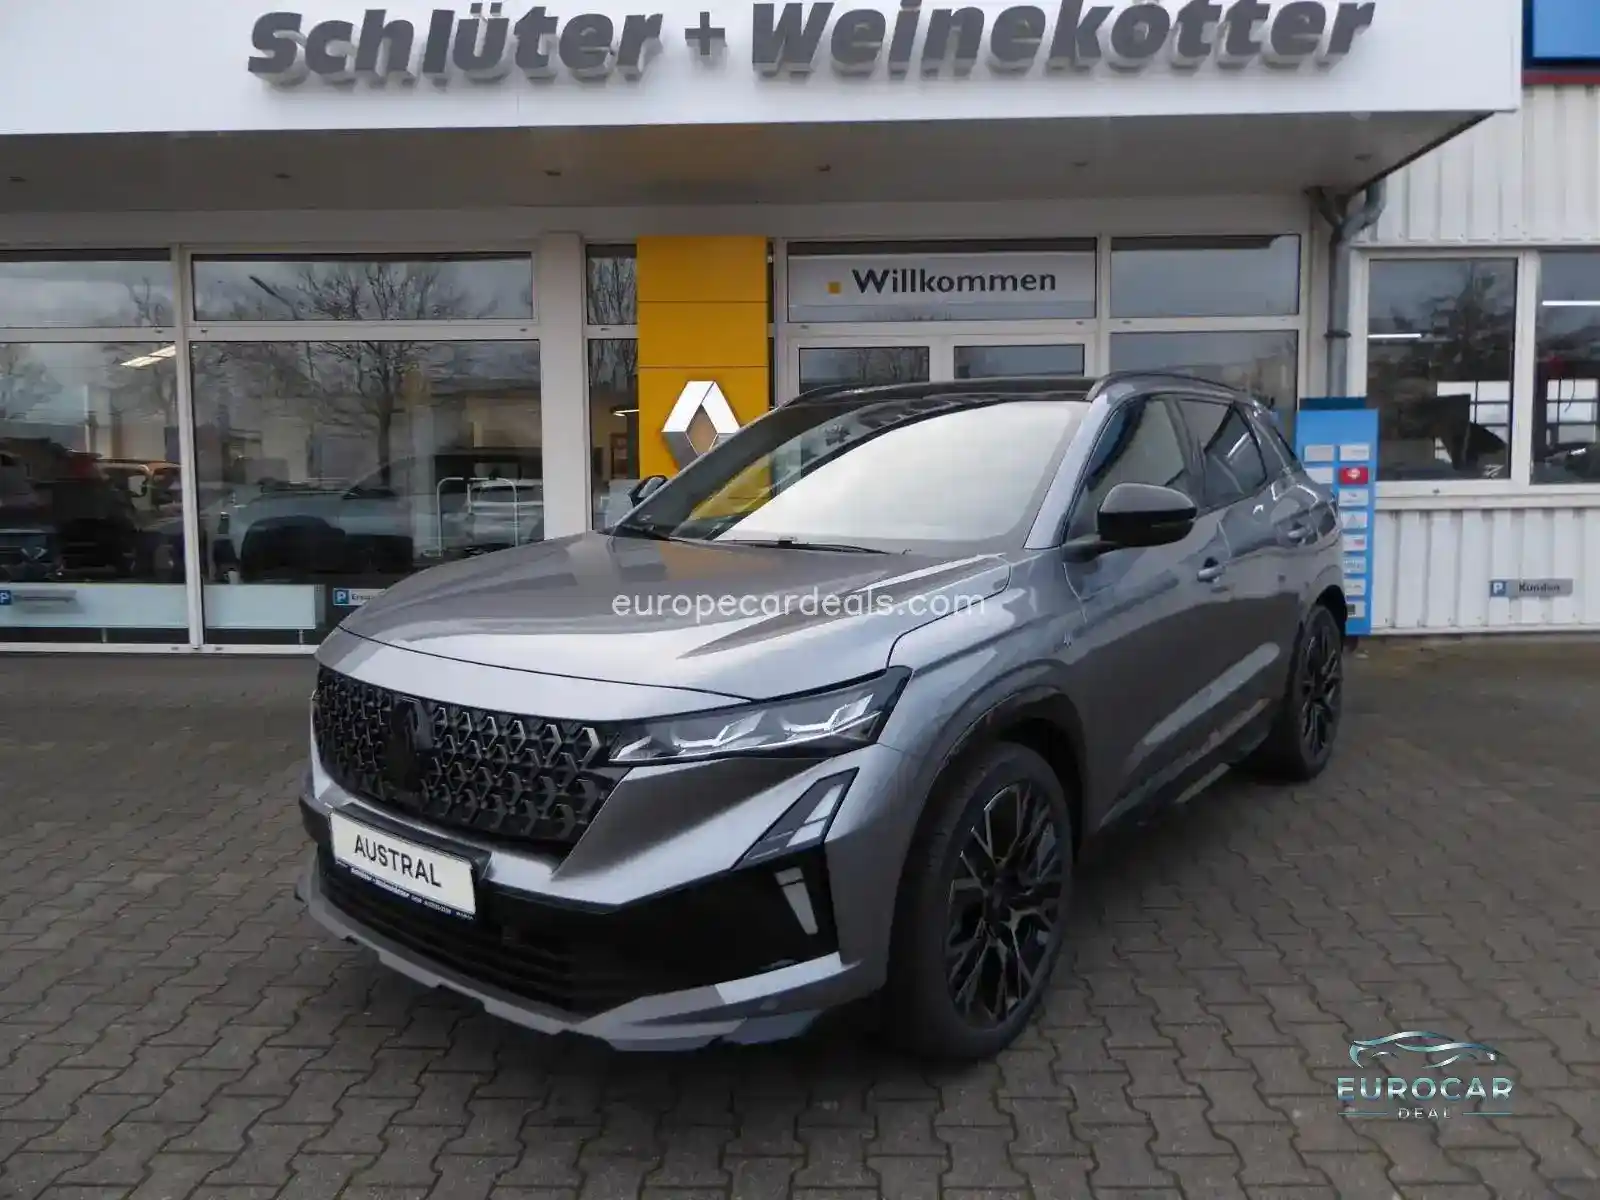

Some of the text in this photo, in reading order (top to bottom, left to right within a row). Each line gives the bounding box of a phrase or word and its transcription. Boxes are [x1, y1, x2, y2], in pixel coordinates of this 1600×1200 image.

[248, 2, 664, 80] Schlüter
[685, 11, 726, 57] +
[852, 267, 1056, 294] Willkommen
[354, 834, 442, 888] AUSTRAL
